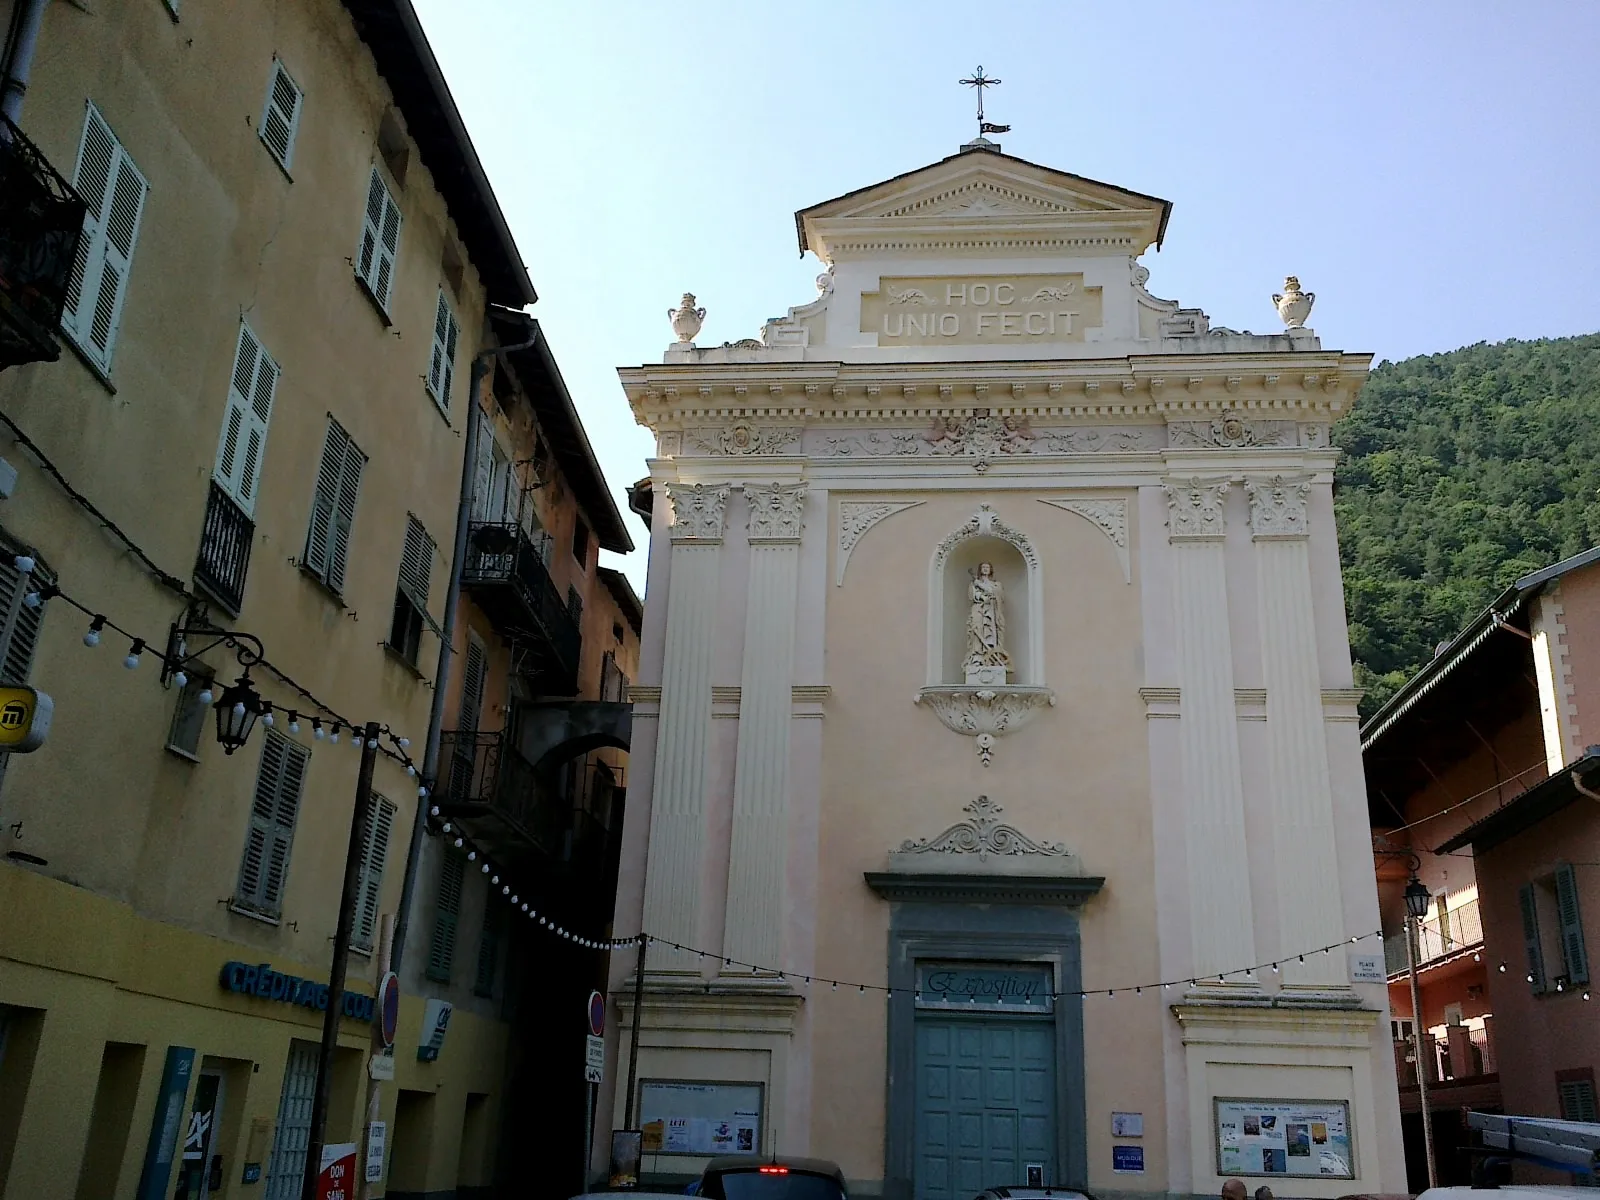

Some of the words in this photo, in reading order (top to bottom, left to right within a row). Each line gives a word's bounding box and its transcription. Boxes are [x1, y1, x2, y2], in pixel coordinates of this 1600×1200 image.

[946, 282, 1016, 306] HOC
[883, 312, 960, 337] UNIO
[976, 310, 1081, 337] FECIT
[220, 960, 303, 1004] CRÉDIT
[301, 980, 375, 1022] AGCOL
[928, 971, 1040, 996] Exposition
[330, 1164, 345, 1179] DON
